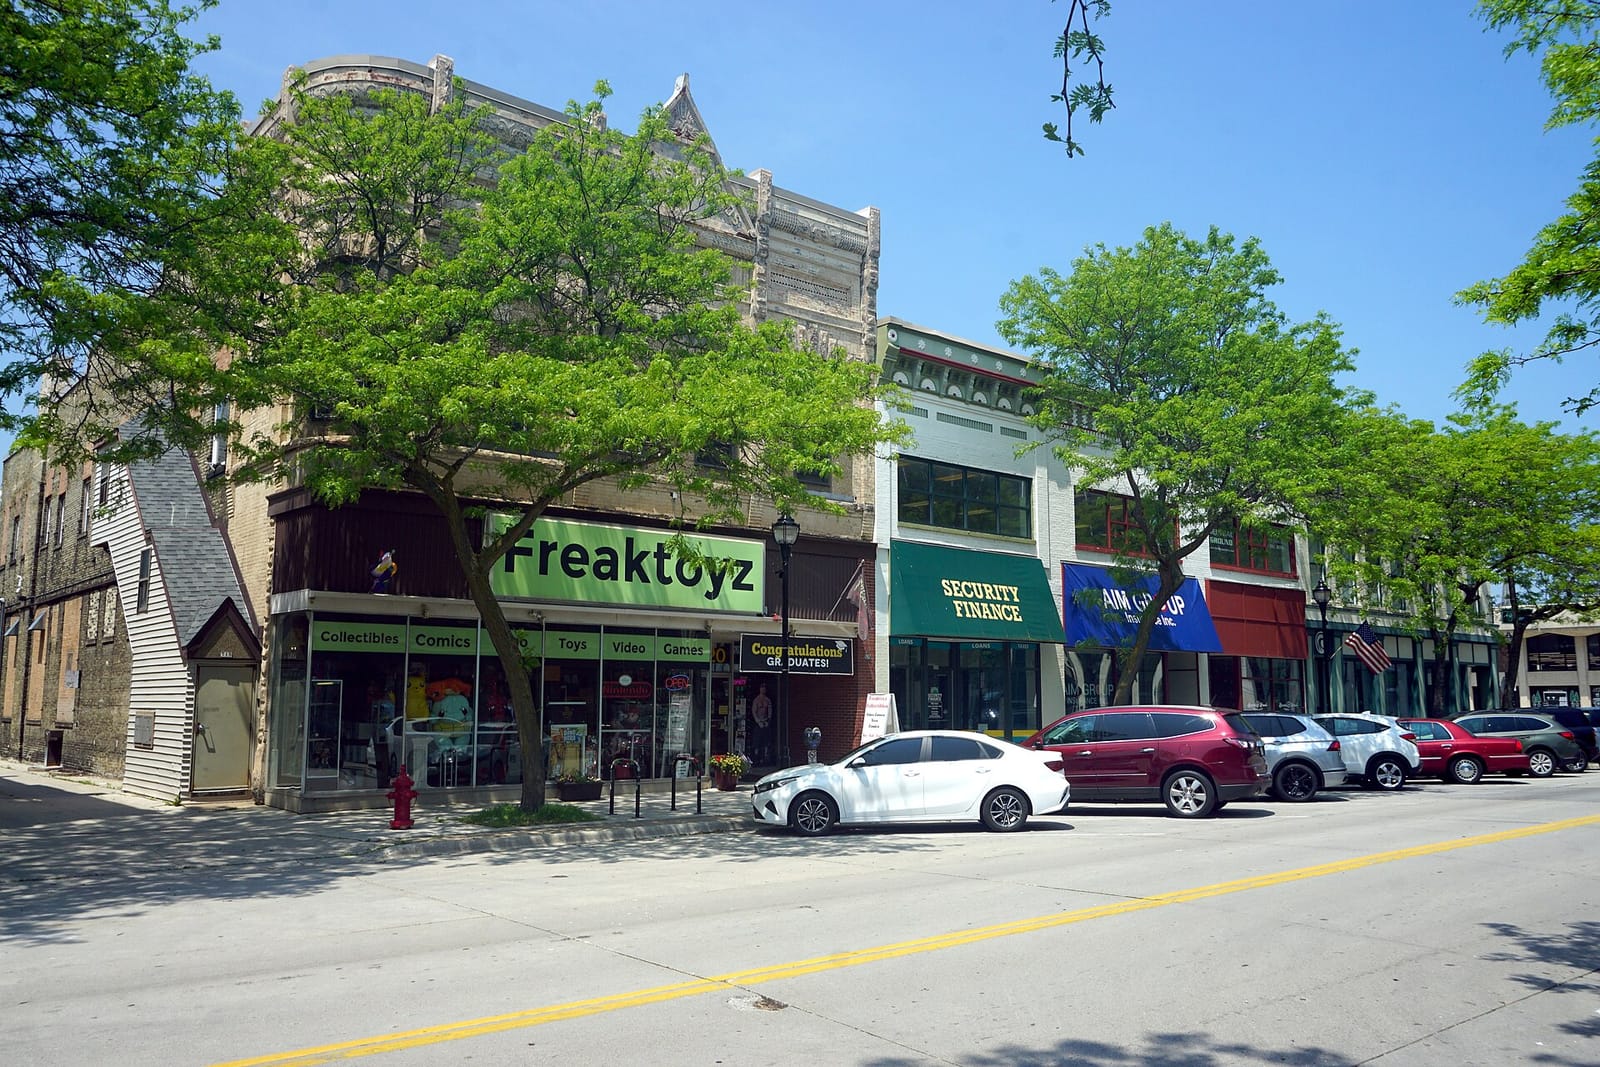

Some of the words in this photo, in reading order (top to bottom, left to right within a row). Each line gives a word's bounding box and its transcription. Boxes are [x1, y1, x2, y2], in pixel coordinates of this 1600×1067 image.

[504, 528, 754, 600] Freaktoyz
[942, 579, 1019, 603] SECURITY
[1102, 588, 1132, 611] AIM
[952, 599, 1023, 622] FINANCE
[320, 630, 399, 645] Collectibles
[415, 633, 471, 648] Comics
[558, 637, 587, 651] Toys
[612, 640, 646, 654] Video
[663, 642, 704, 657] Games
[751, 641, 843, 658] Congatulations
[766, 656, 830, 668] GRDUATES!
[666, 679, 689, 688] OPEN
